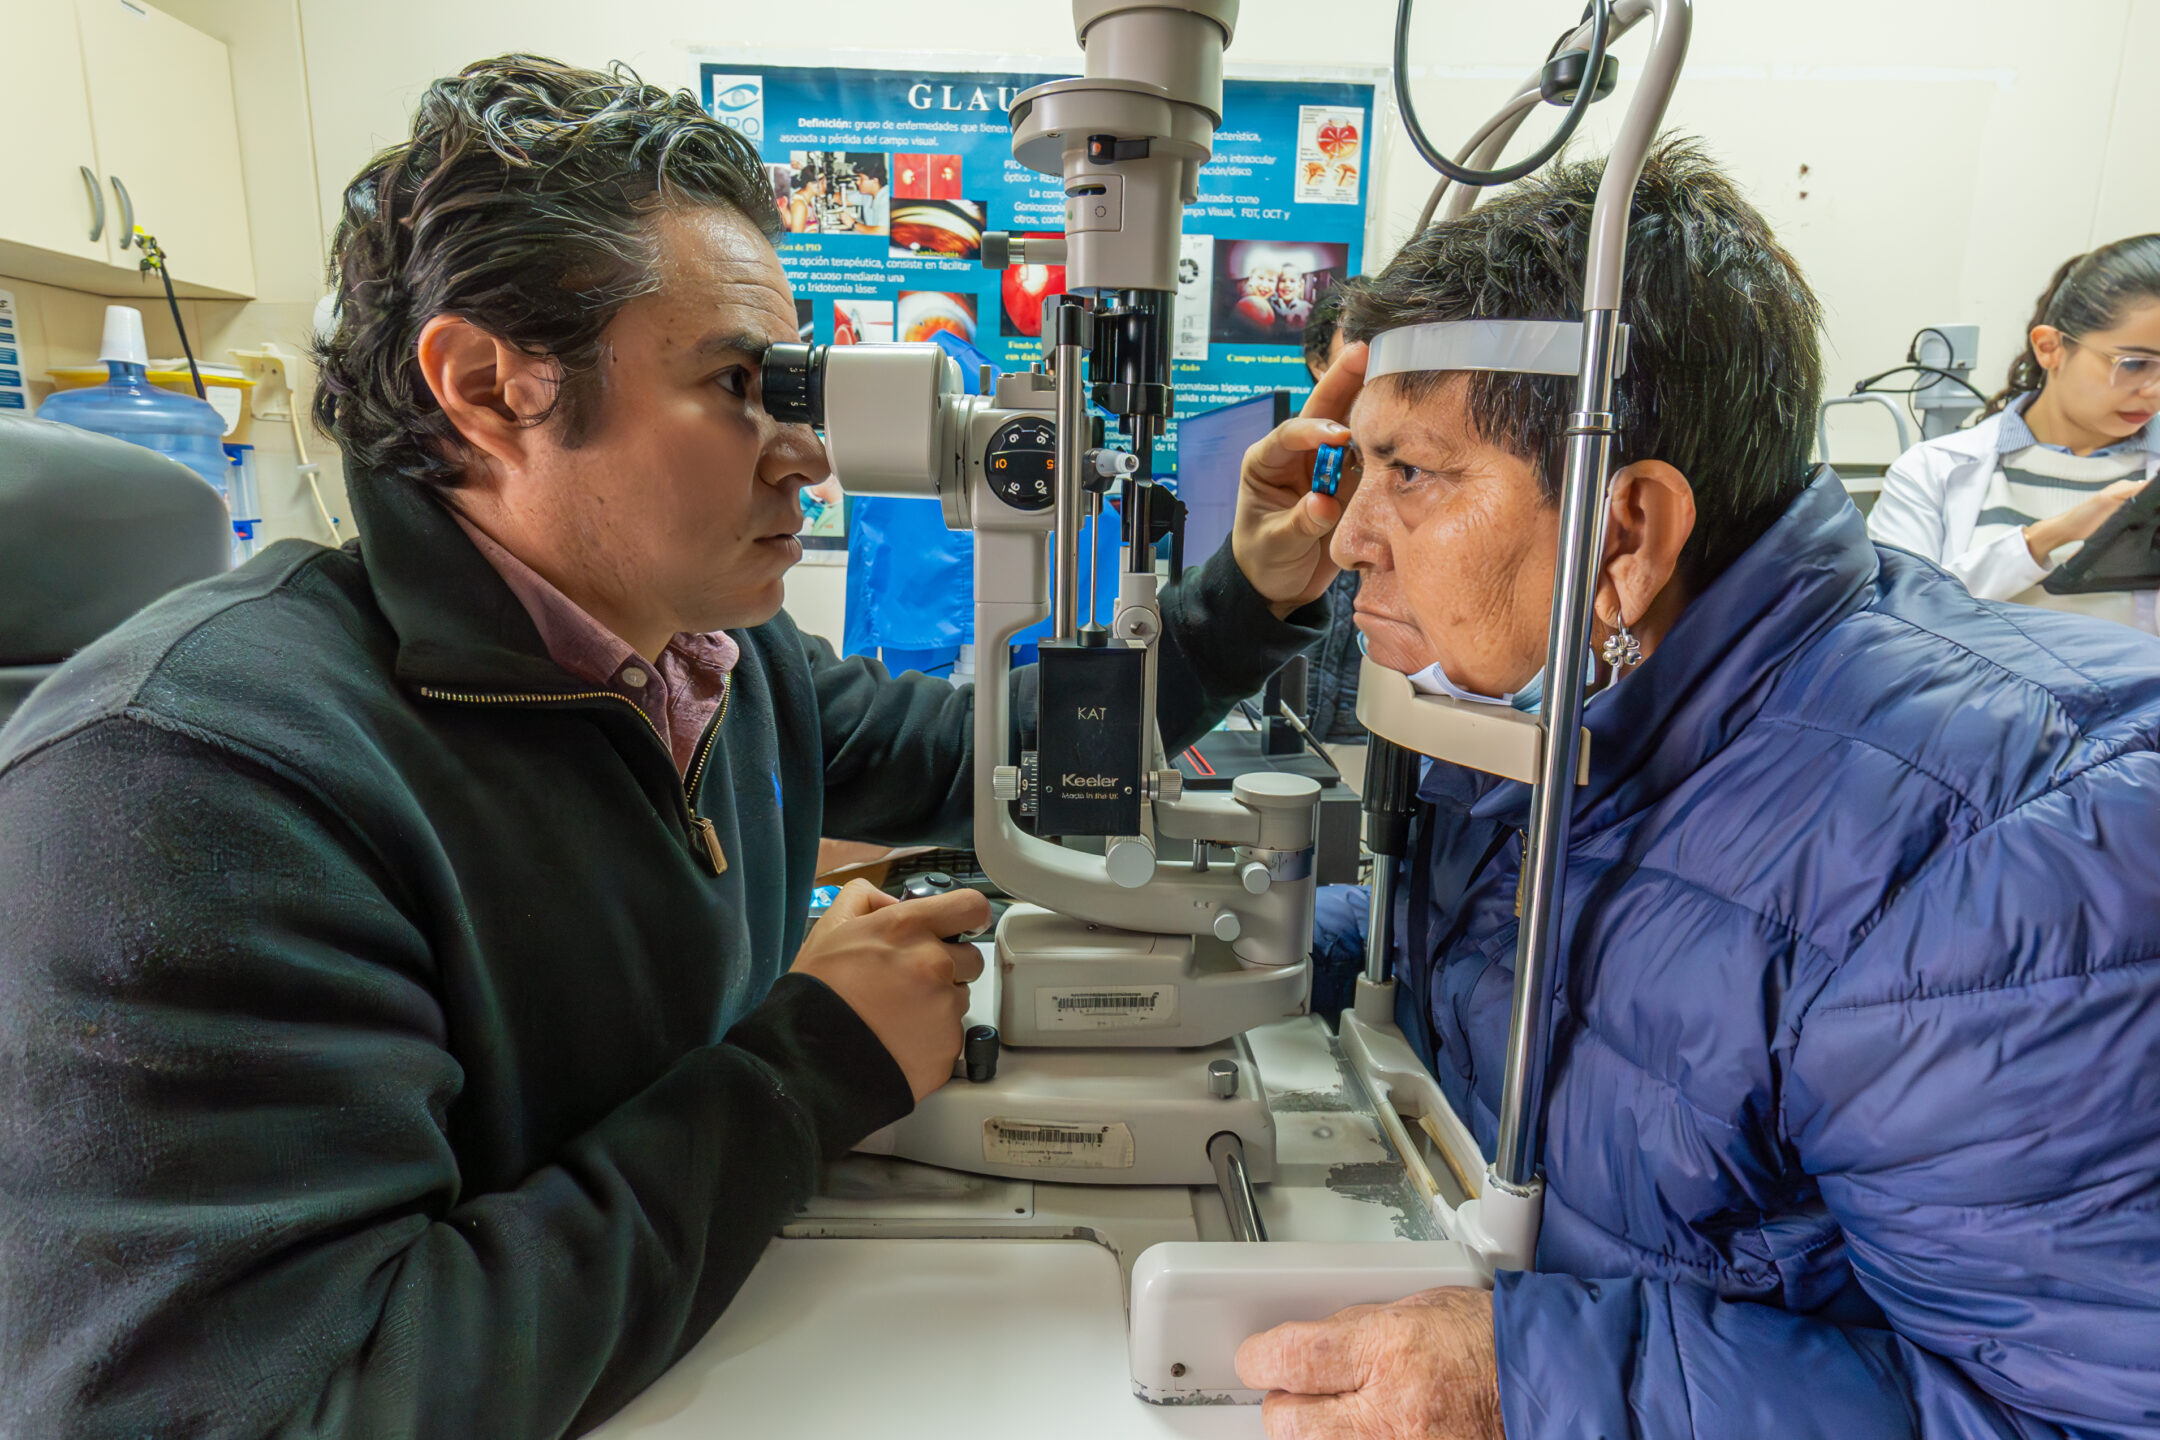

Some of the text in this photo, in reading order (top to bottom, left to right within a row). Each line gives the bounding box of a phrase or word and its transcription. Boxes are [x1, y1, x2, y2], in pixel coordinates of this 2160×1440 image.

[908, 84, 1019, 112] GLAU
[798, 118, 852, 129] Definición:
[854, 121, 880, 131] grupo
[882, 120, 894, 130] de
[896, 121, 958, 132] enfermedades
[961, 124, 977, 133] que
[980, 123, 1008, 133] tienen
[780, 133, 818, 142] asociada
[828, 134, 861, 144] pérdida
[864, 135, 876, 144] del
[879, 137, 909, 146] campo
[912, 136, 938, 146] visual.
[1230, 155, 1277, 165] intraocular
[1029, 189, 1040, 198] La
[1236, 196, 1260, 204] como
[1263, 209, 1282, 218] OCT
[1284, 212, 1290, 220] y
[800, 256, 829, 267] opción
[832, 257, 884, 268] terapéutica,
[886, 260, 922, 269] consiste
[939, 260, 972, 270] facilitar
[811, 272, 841, 280] acuoso
[844, 272, 885, 282] mediante
[798, 284, 806, 292] o
[1226, 354, 1256, 364] Campo
[996, 458, 1007, 468] 10
[1046, 460, 1054, 469] 5
[1078, 706, 1107, 720] KAT
[1062, 774, 1119, 787] Keeler
